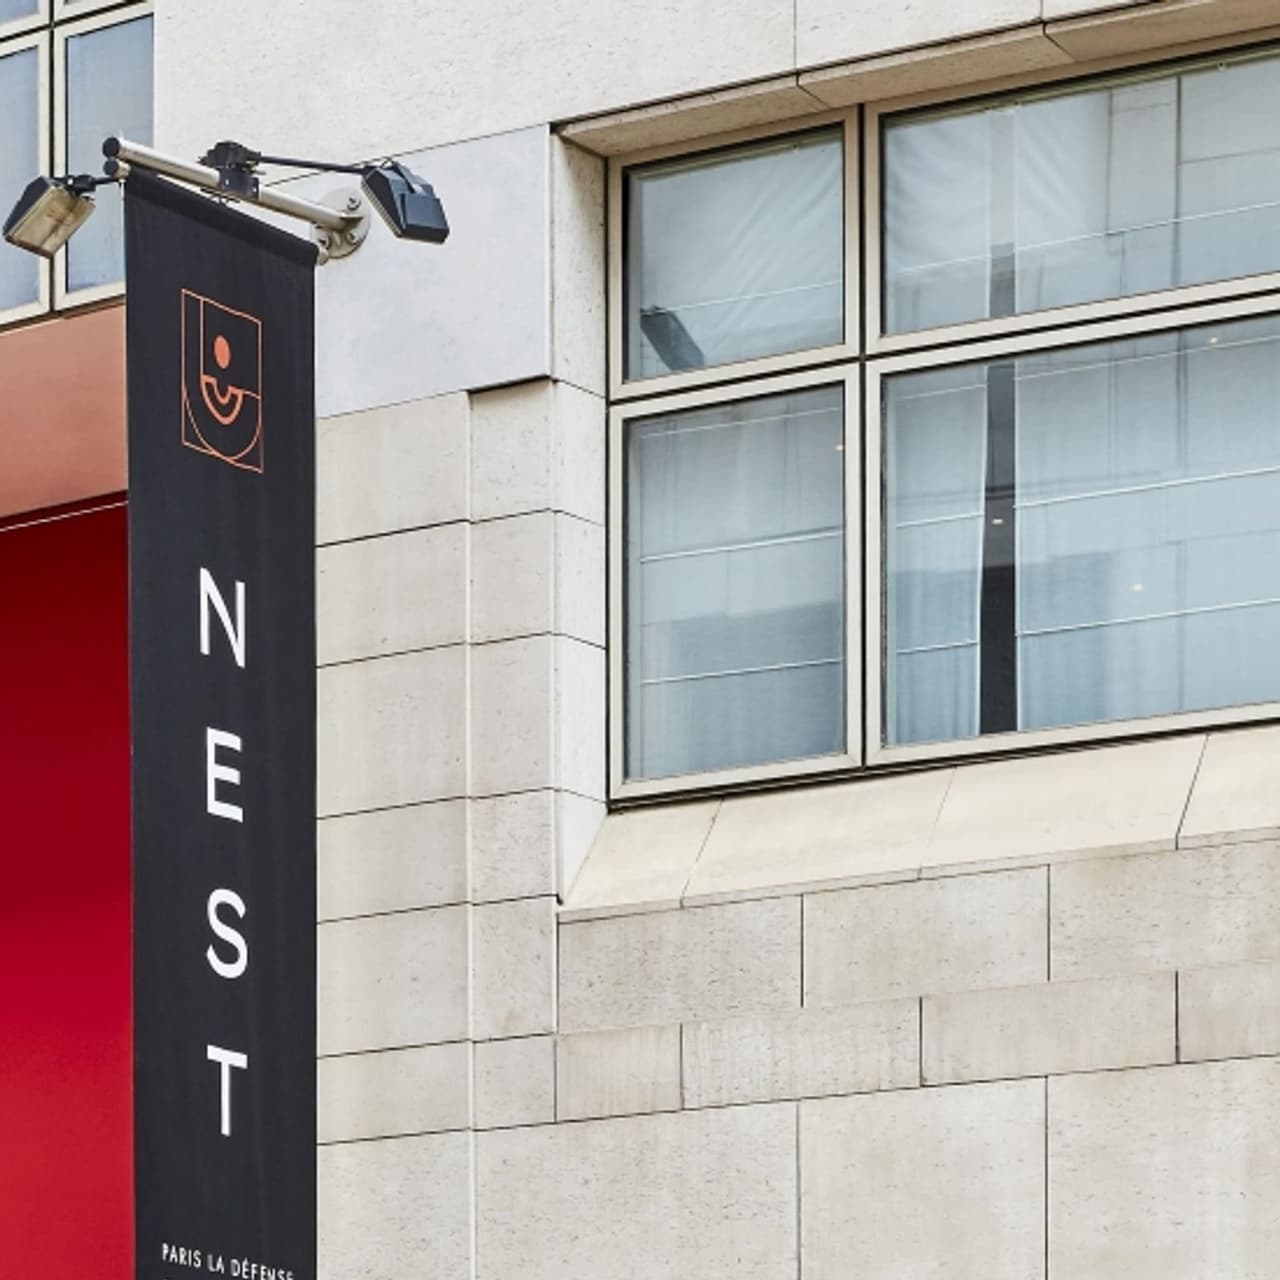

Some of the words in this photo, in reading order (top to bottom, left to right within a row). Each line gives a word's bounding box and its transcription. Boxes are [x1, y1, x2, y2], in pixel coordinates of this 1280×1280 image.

[199, 567, 248, 1137] NEST
[162, 1242, 202, 1269] PARIS
[207, 1254, 225, 1274] LA
